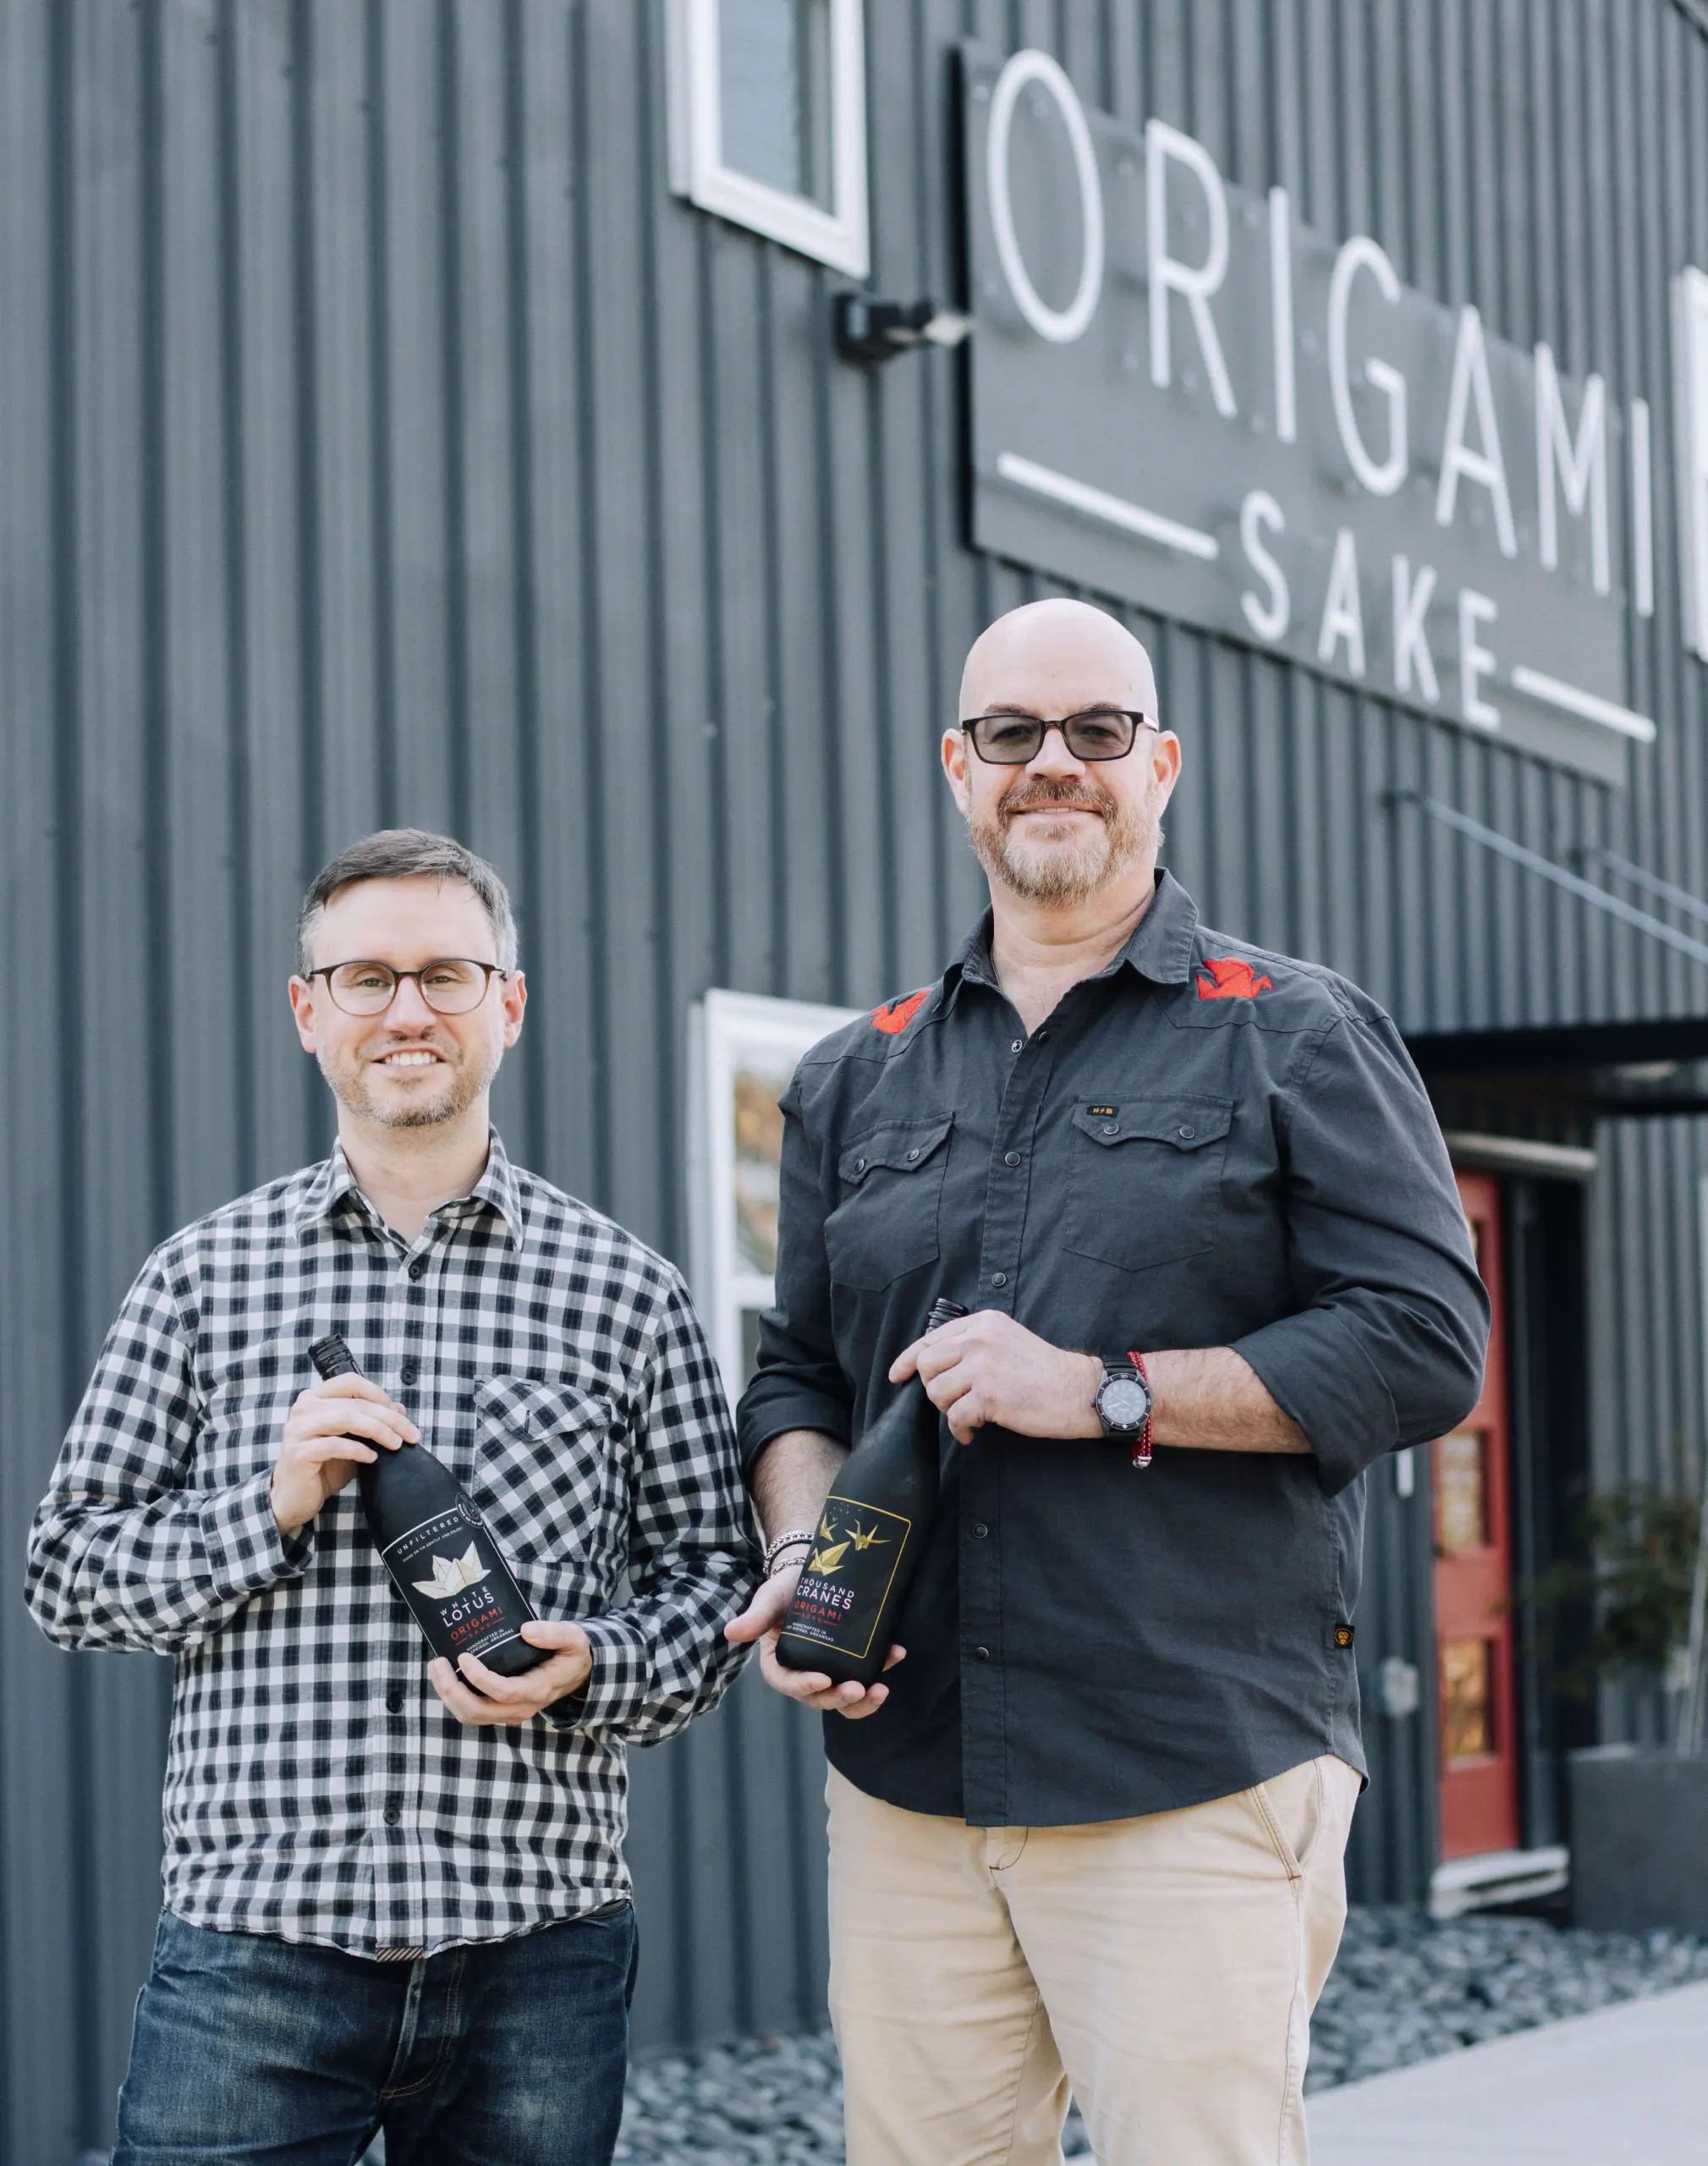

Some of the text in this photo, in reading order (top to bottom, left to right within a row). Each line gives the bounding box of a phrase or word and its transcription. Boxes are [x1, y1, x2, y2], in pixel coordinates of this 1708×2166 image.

[986, 48, 1654, 620] ORIGAMI
[1241, 490, 1501, 733] SAKE
[397, 1516, 459, 1554] UNFILTERED
[426, 1537, 441, 1548] GENTLY
[440, 1586, 488, 1616] WHITE
[796, 1585, 852, 1609] CRANES
[801, 1577, 854, 1598] THOUSAND
[442, 1592, 494, 1627] LOTUS
[450, 1605, 503, 1640] ORIGAMI
[794, 1600, 843, 1621] ORIGAMI
[466, 1631, 498, 1652] HANDCRAFTED
[809, 1630, 834, 1642] ARKANSAS
